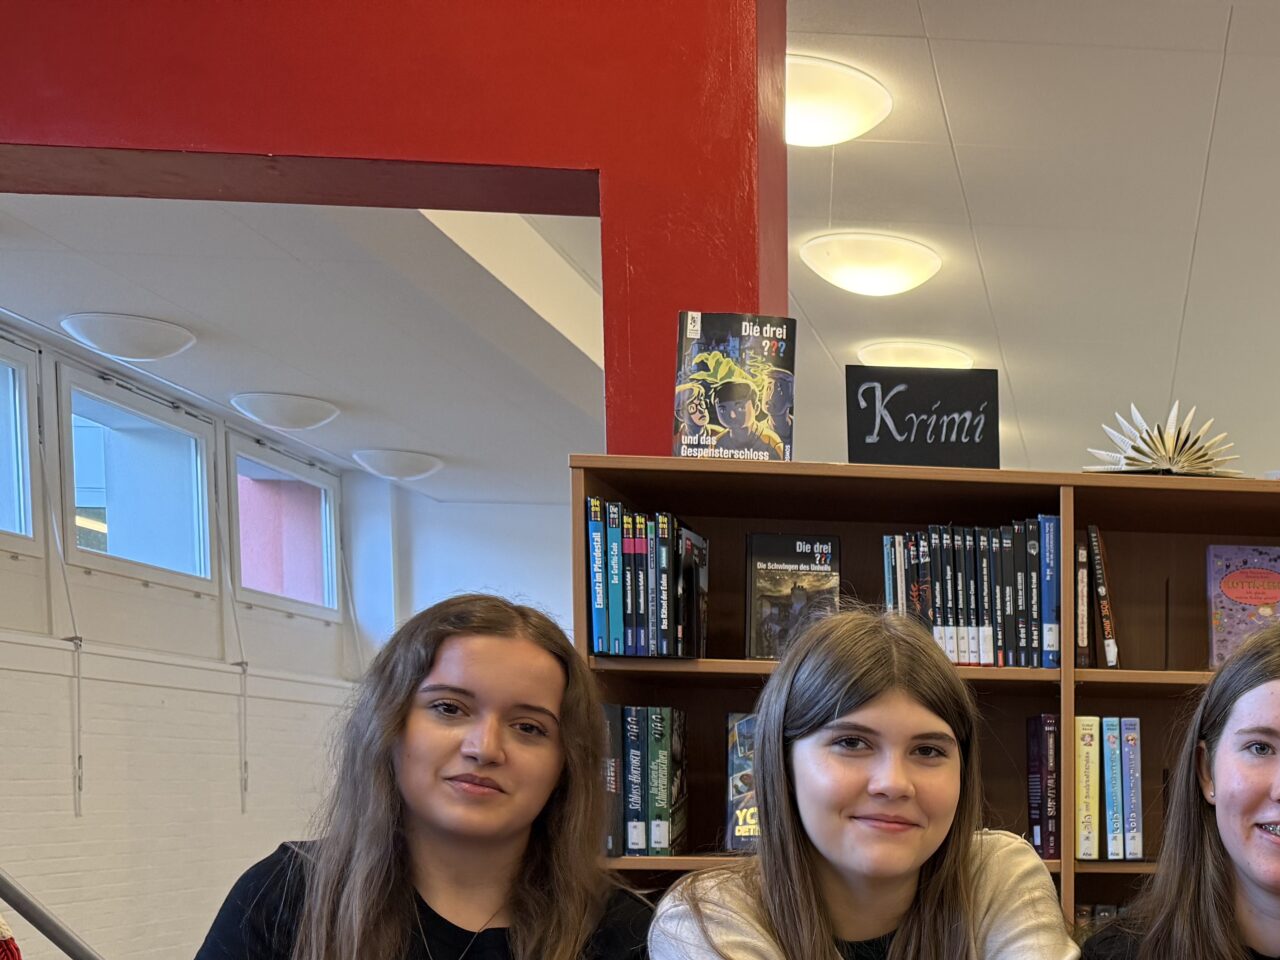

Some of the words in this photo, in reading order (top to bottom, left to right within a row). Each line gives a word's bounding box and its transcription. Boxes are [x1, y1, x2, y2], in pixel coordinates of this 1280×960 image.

[742, 322, 760, 337] Die
[763, 324, 786, 338] drei
[762, 340, 786, 356] ???
[858, 381, 988, 443] Krimi
[681, 434, 699, 445] und
[700, 435, 717, 446] das
[681, 445, 770, 461] Gespensterschloss
[796, 541, 811, 553] Die
[813, 542, 832, 554] drei
